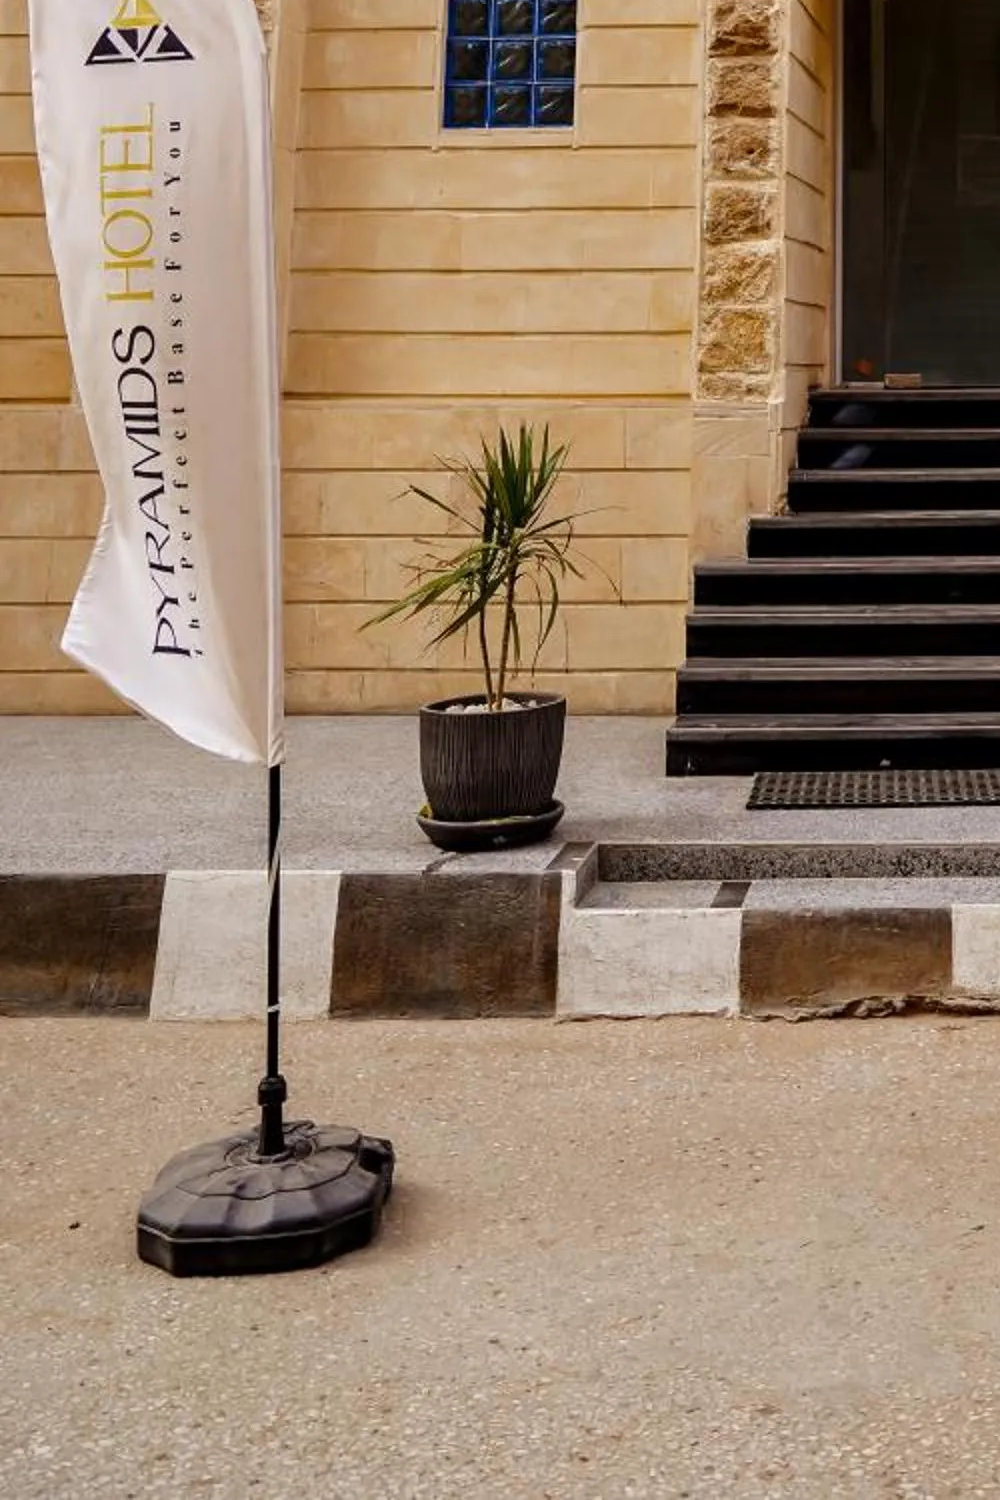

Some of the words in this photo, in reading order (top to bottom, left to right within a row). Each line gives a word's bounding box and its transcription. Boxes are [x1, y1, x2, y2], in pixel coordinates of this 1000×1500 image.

[99, 102, 155, 301] HOTEL
[164, 121, 181, 187] You
[164, 206, 182, 271] For
[167, 293, 184, 384] Base
[112, 325, 192, 657] PYRAMIDS
[172, 406, 195, 569] Perfect
